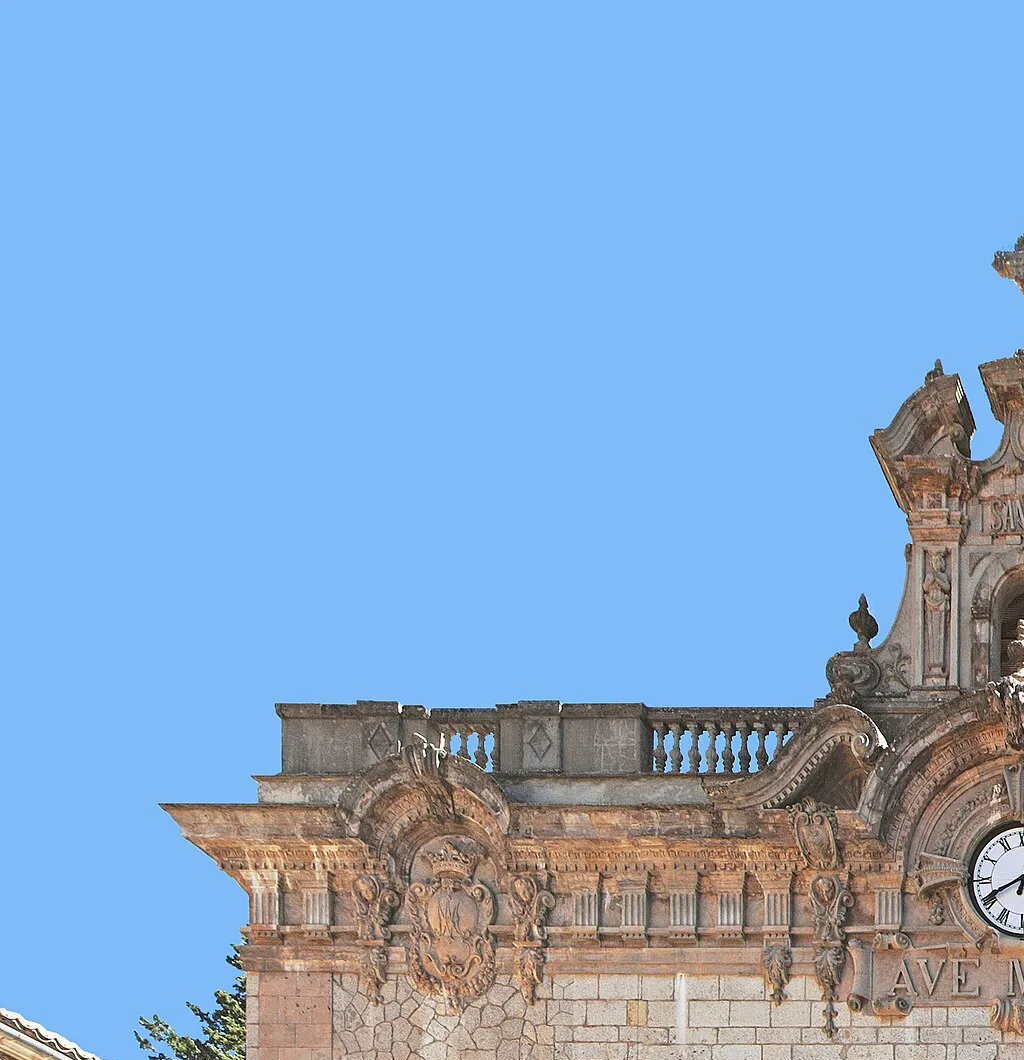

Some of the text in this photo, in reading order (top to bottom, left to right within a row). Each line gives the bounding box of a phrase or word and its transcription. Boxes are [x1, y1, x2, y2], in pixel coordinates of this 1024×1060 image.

[999, 837, 1011, 853] XI
[983, 854, 997, 866] X
[888, 958, 981, 997] AVE
